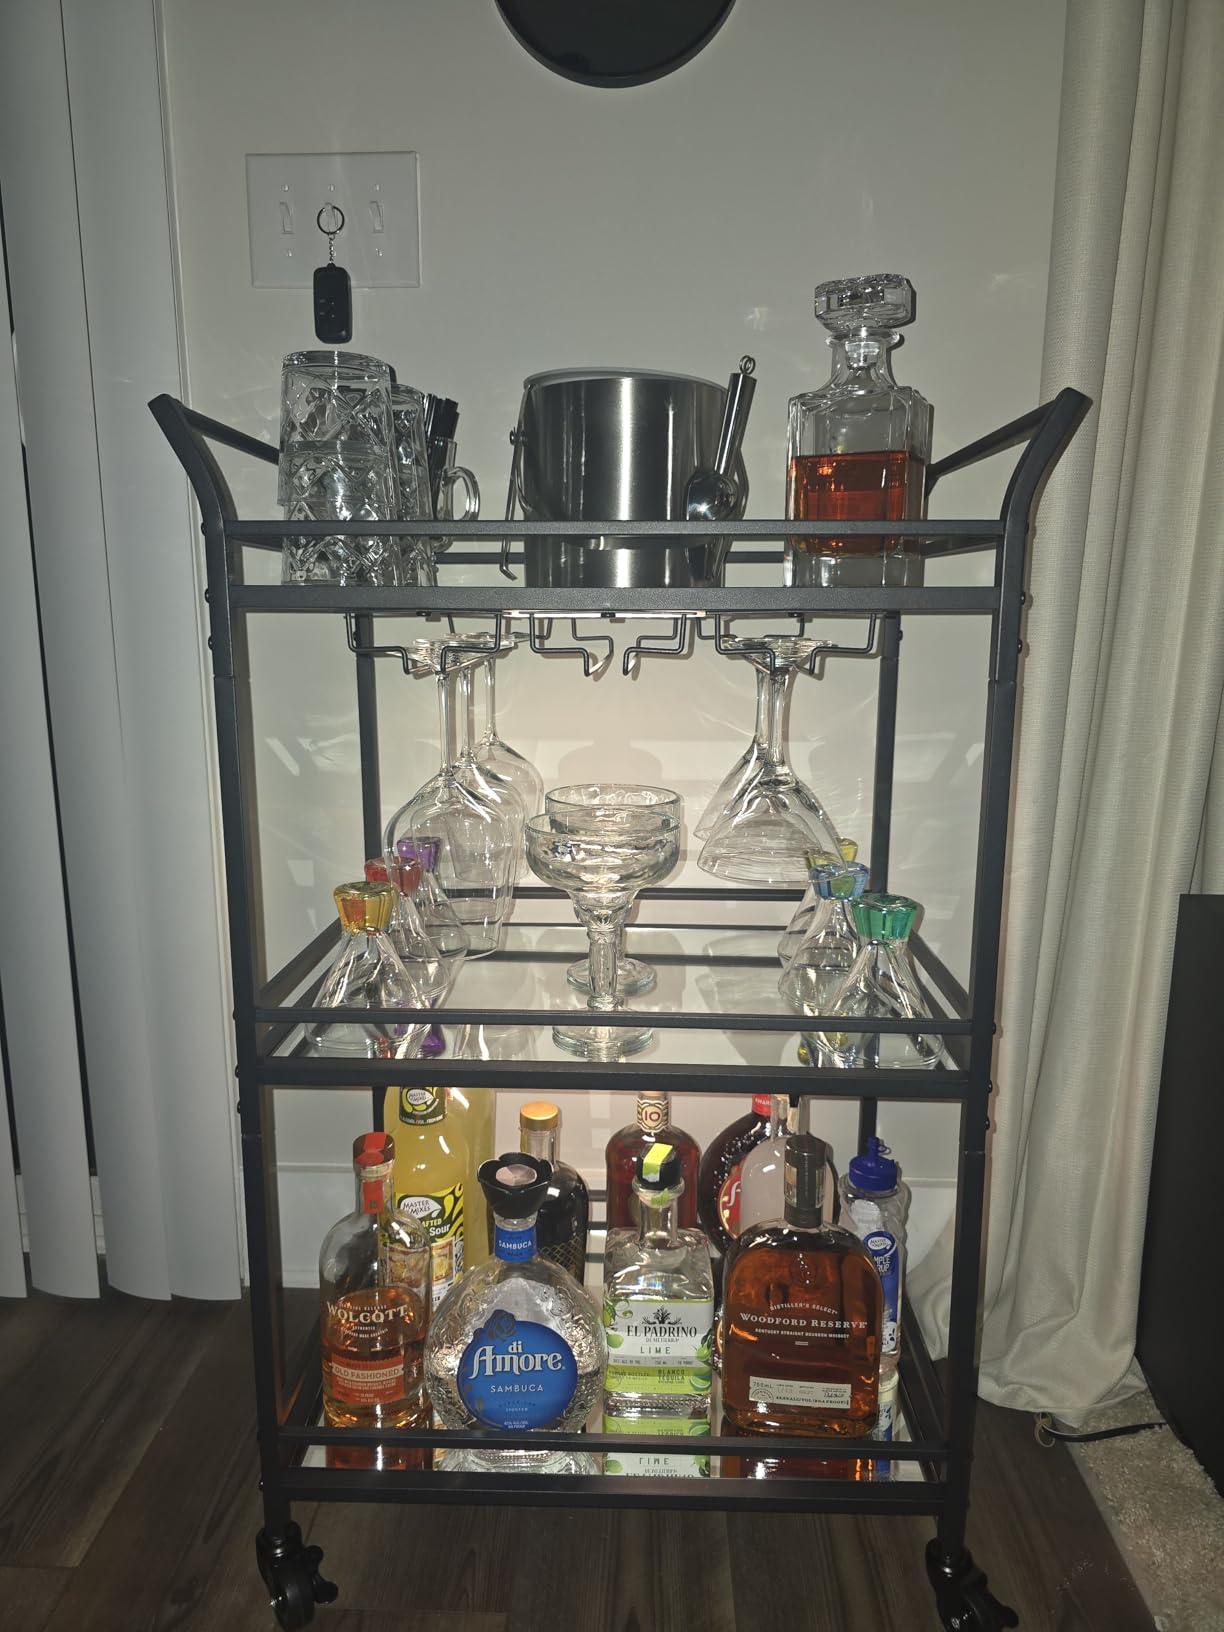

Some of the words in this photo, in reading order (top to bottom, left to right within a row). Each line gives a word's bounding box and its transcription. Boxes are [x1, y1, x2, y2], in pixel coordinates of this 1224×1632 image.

[645, 1110, 661, 1122] 10
[403, 1199, 430, 1212] MASTER
[410, 1206, 431, 1216] MIXES
[429, 1224, 451, 1237] Sour
[498, 1240, 532, 1250] SAMBUCA
[874, 1256, 891, 1265] MPLE
[327, 1301, 408, 1324] WOLCOTT
[770, 1302, 810, 1311] DISTILLER'S
[740, 1312, 807, 1327] WOODFORD
[811, 1319, 867, 1329] RESERVE
[627, 1325, 640, 1337] EL
[644, 1325, 697, 1338] PADRINO
[508, 1340, 523, 1353] di
[640, 1346, 671, 1354] LIME
[468, 1345, 563, 1379] Amore
[335, 1366, 349, 1377] OLD
[351, 1368, 400, 1380] FASHIONED
[490, 1384, 544, 1393] SAMBUCA
